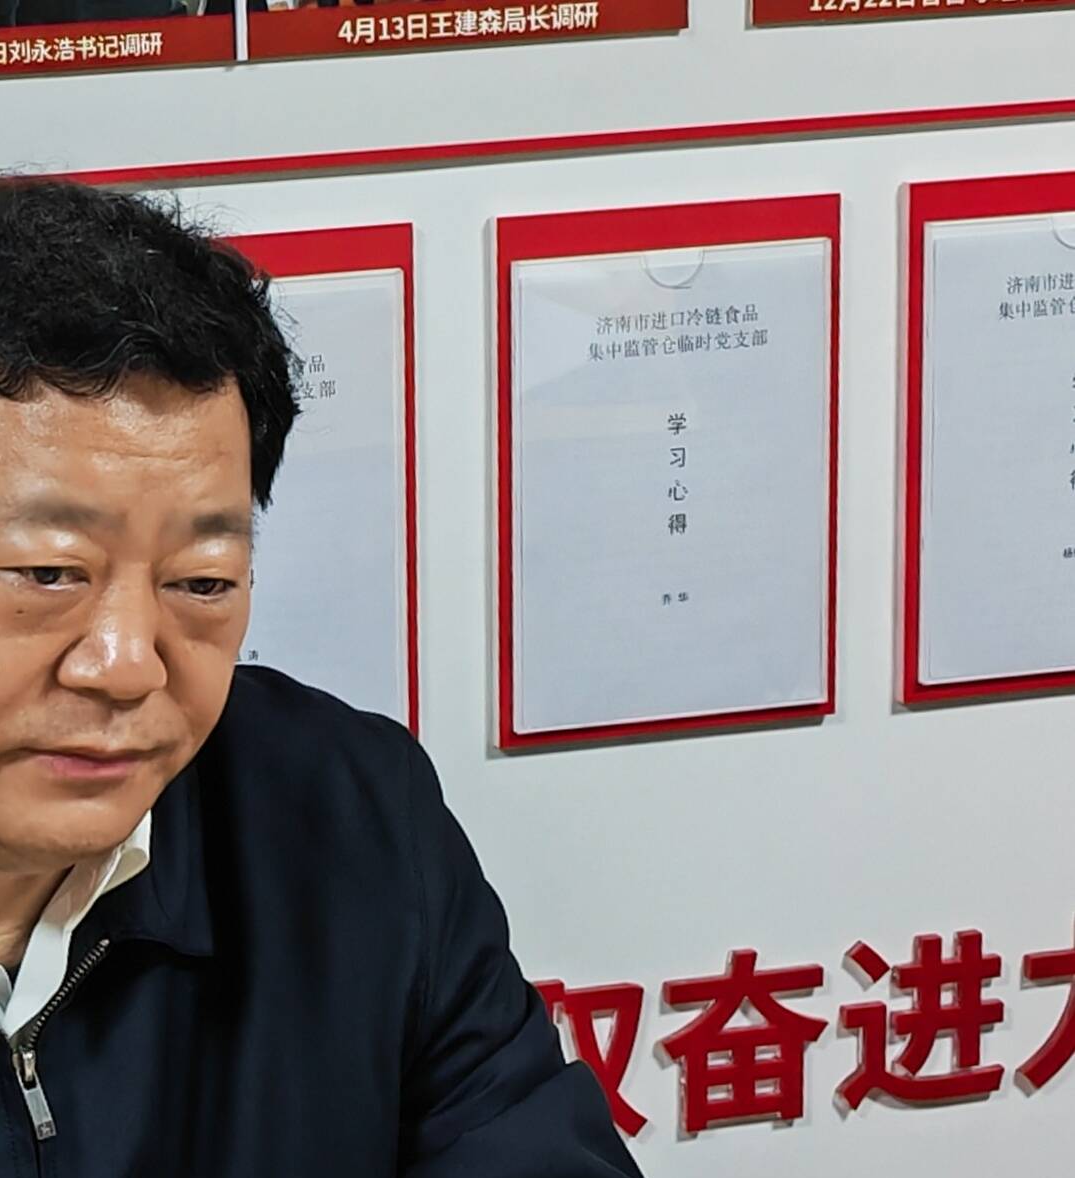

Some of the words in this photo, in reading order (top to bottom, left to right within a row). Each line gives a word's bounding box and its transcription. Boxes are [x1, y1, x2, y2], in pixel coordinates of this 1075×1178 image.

[337, 3, 599, 44] 4月13日王建森局长调研
[595, 304, 759, 335] 济南市进口冷链食品
[588, 329, 768, 361] 集中监管仓临时党支部
[666, 412, 689, 536] 学习心得
